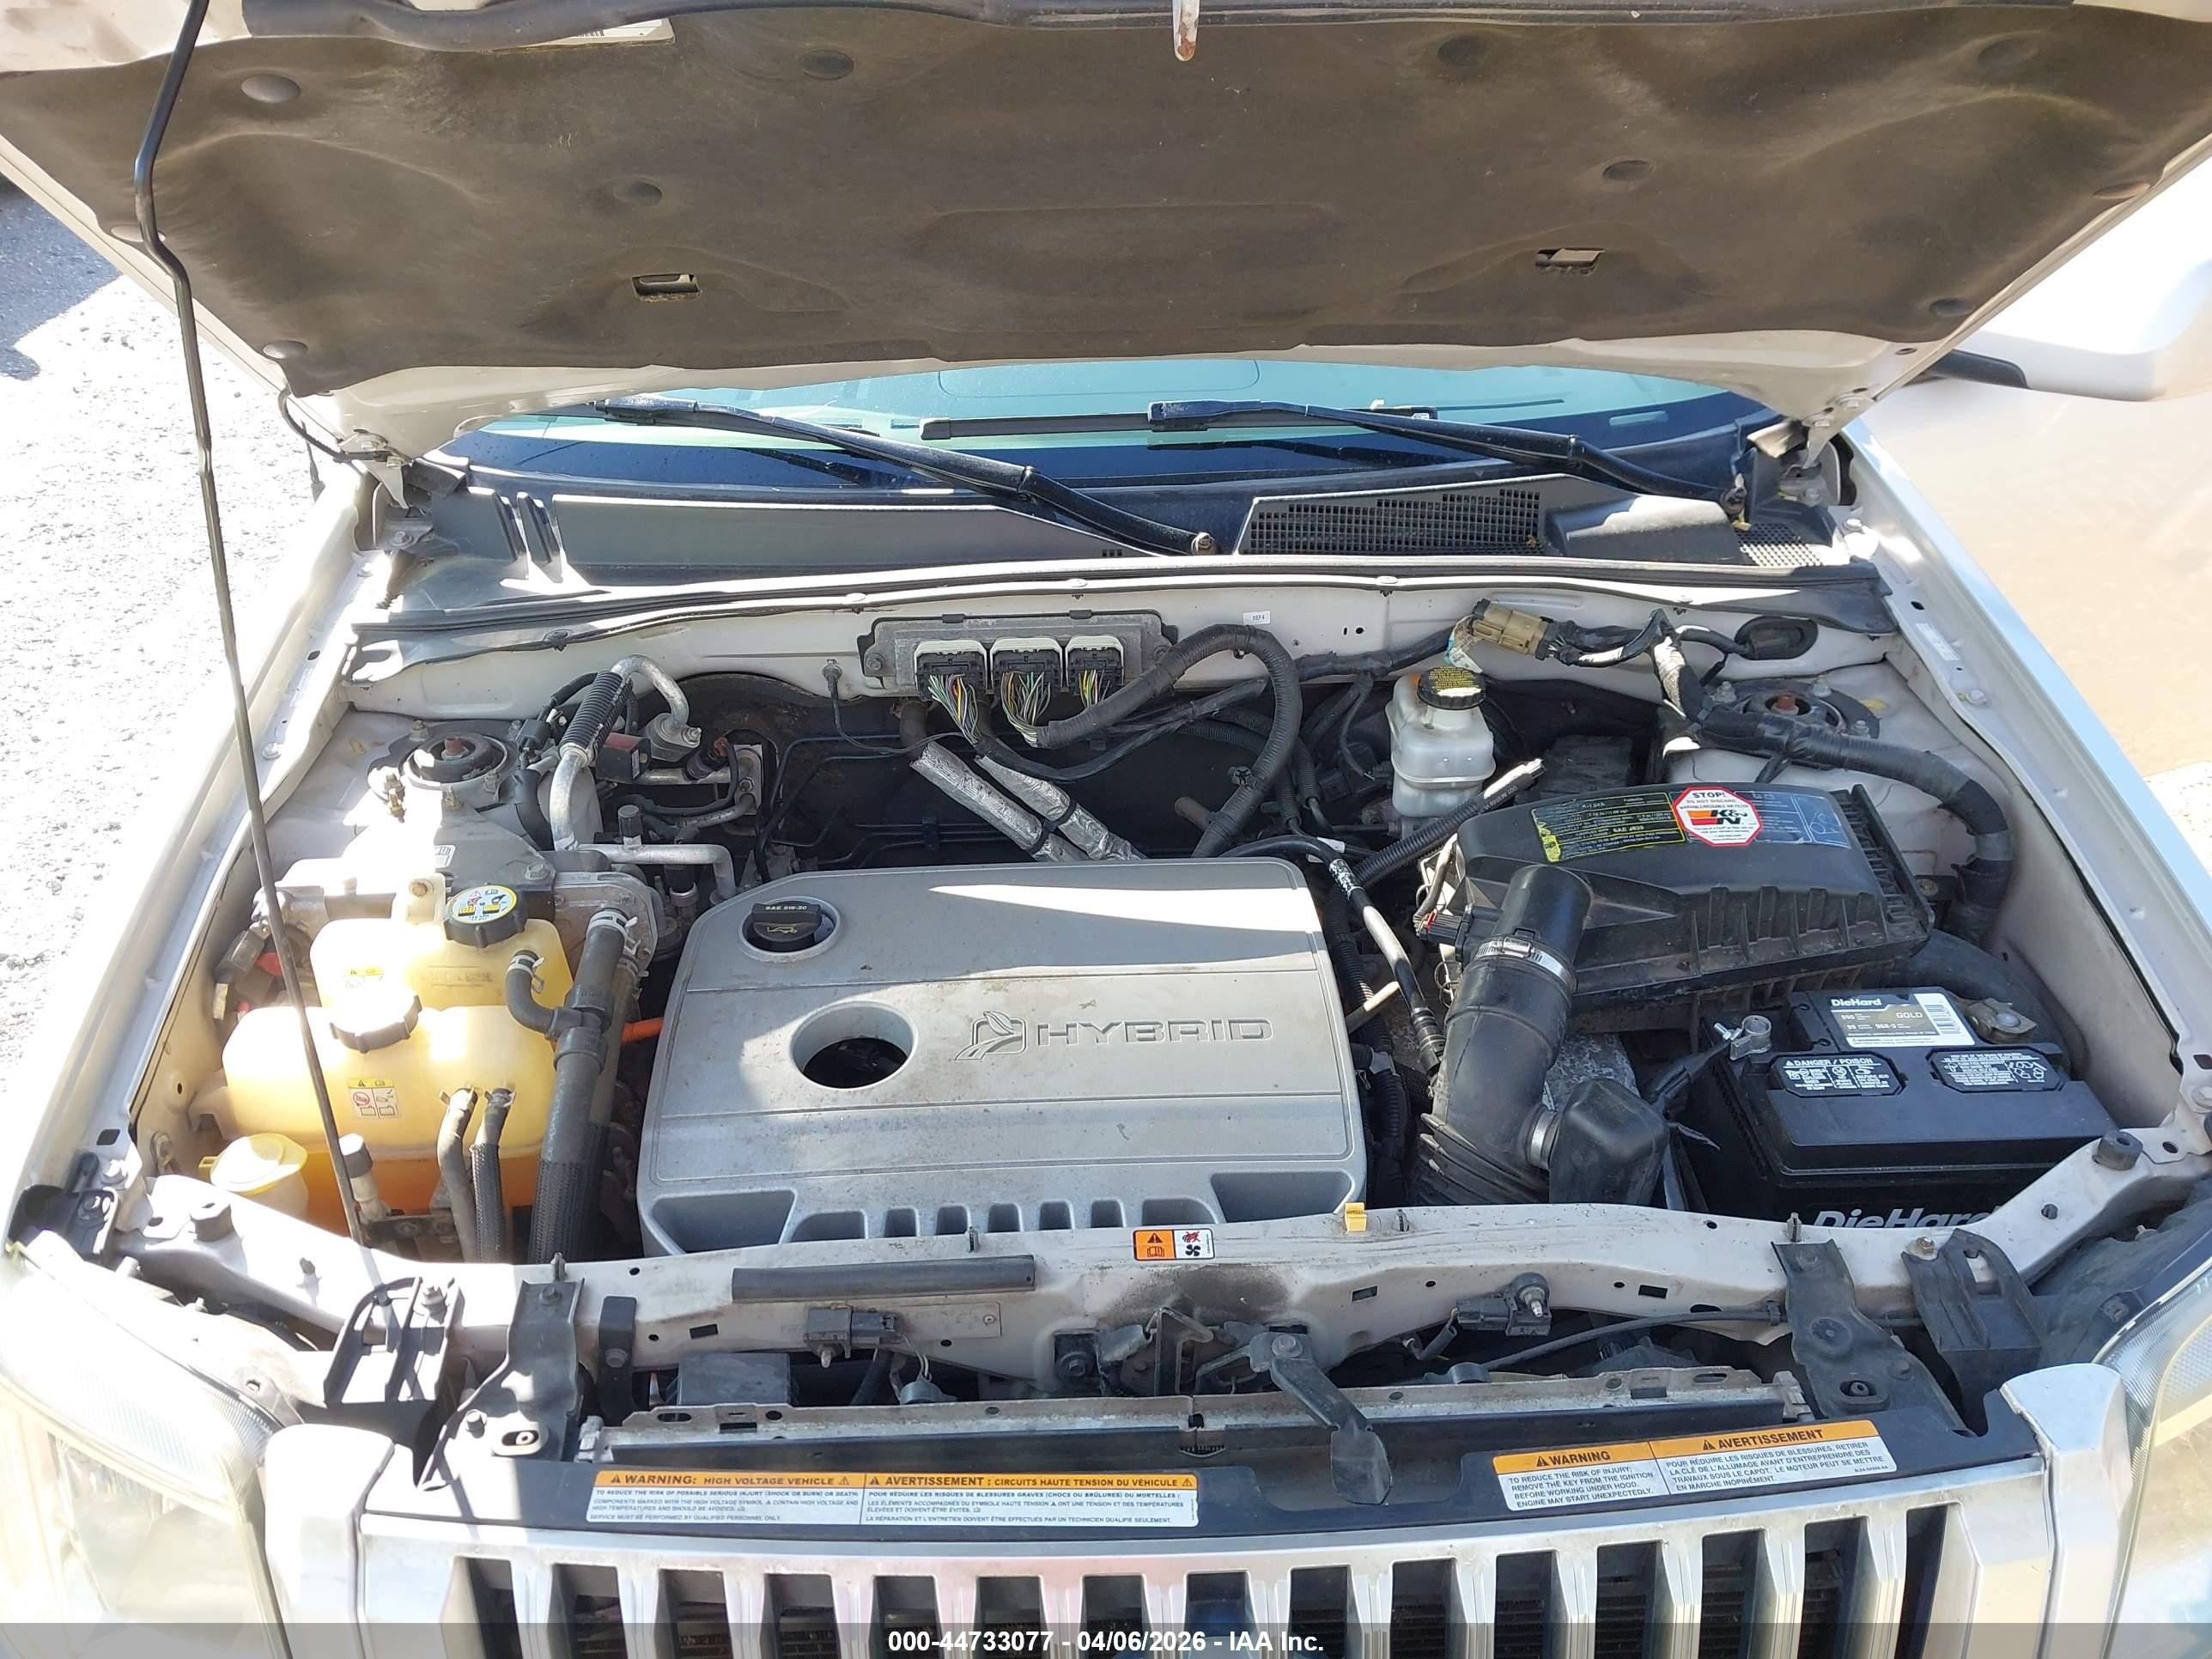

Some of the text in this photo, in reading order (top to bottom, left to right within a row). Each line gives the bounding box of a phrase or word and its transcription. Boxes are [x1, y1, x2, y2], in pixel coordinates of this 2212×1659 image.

[1830, 998, 1882, 1006] DieHard
[1037, 1017, 1274, 1046] HYBRID
[1718, 1429, 1823, 1449] AVERTISSEMENT
[1549, 1451, 1611, 1465] WARNING
[1690, 1455, 1722, 1464] RÉDUIRE
[1741, 1451, 1773, 1460] RISQUES
[1836, 1443, 1867, 1451] RETIRER
[1673, 1474, 1707, 1483] TRAVAUX
[1786, 1462, 1817, 1471] MOTEUR
[1853, 1456, 1883, 1465] METTRE
[1681, 1465, 1695, 1474] CLÉ
[1786, 1451, 1852, 1464] D'ENTREPRENDRE
[625, 1475, 696, 1485] WARNING:
[885, 1477, 984, 1486] AVERTISSEMENT
[1132, 1478, 1178, 1486] VÉHICULE
[1512, 1483, 1543, 1491] REMOVE
[1621, 1473, 1653, 1481] IGNITION
[1521, 1474, 1552, 1483] REDUCE
[1689, 1481, 1721, 1490] MARCHE
[1514, 1491, 1544, 1499] BEFORE
[1547, 1487, 1583, 1496] WORKING
[1587, 1485, 1612, 1493] UNDER
[1517, 1499, 1545, 1507] ENGINE
[1565, 1495, 1589, 1503] START
